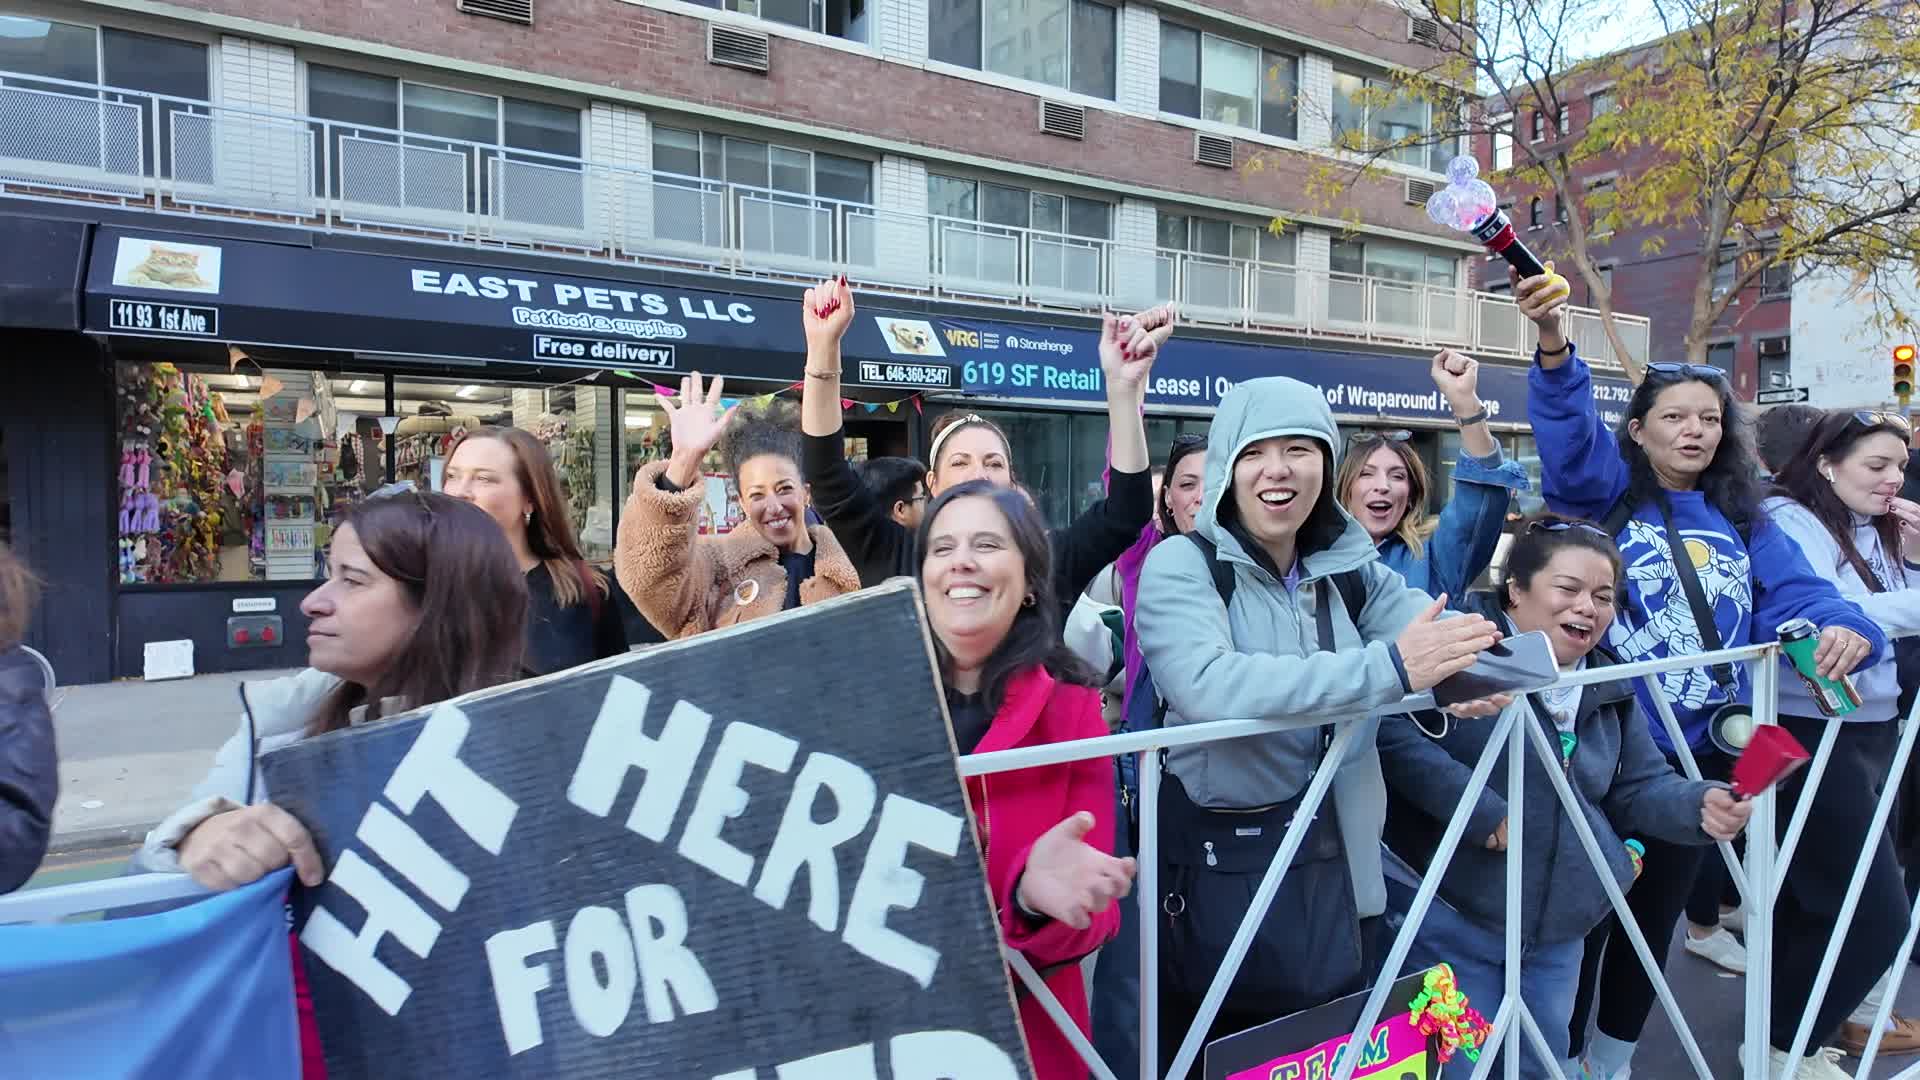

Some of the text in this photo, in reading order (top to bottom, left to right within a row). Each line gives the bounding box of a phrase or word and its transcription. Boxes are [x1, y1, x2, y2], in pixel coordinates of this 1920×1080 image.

[411, 268, 756, 324] EAST PETS LLC
[158, 306, 180, 330] 1st
[181, 308, 206, 332] Ave
[517, 309, 683, 338] Pet food & supplies
[538, 336, 671, 366] Free delivery
[943, 329, 979, 348] WRG
[1019, 337, 1073, 355] Stonehenge
[886, 365, 948, 384] 646-360-2547
[963, 360, 1005, 386] 619
[1011, 363, 1039, 387] SF
[1043, 366, 1101, 391] Retail
[1145, 375, 1201, 397] Lease
[1326, 383, 1345, 405] of
[1347, 385, 1437, 412] Wraparound
[299, 673, 965, 1017] HIT HERE
[483, 883, 720, 1057] FOR
